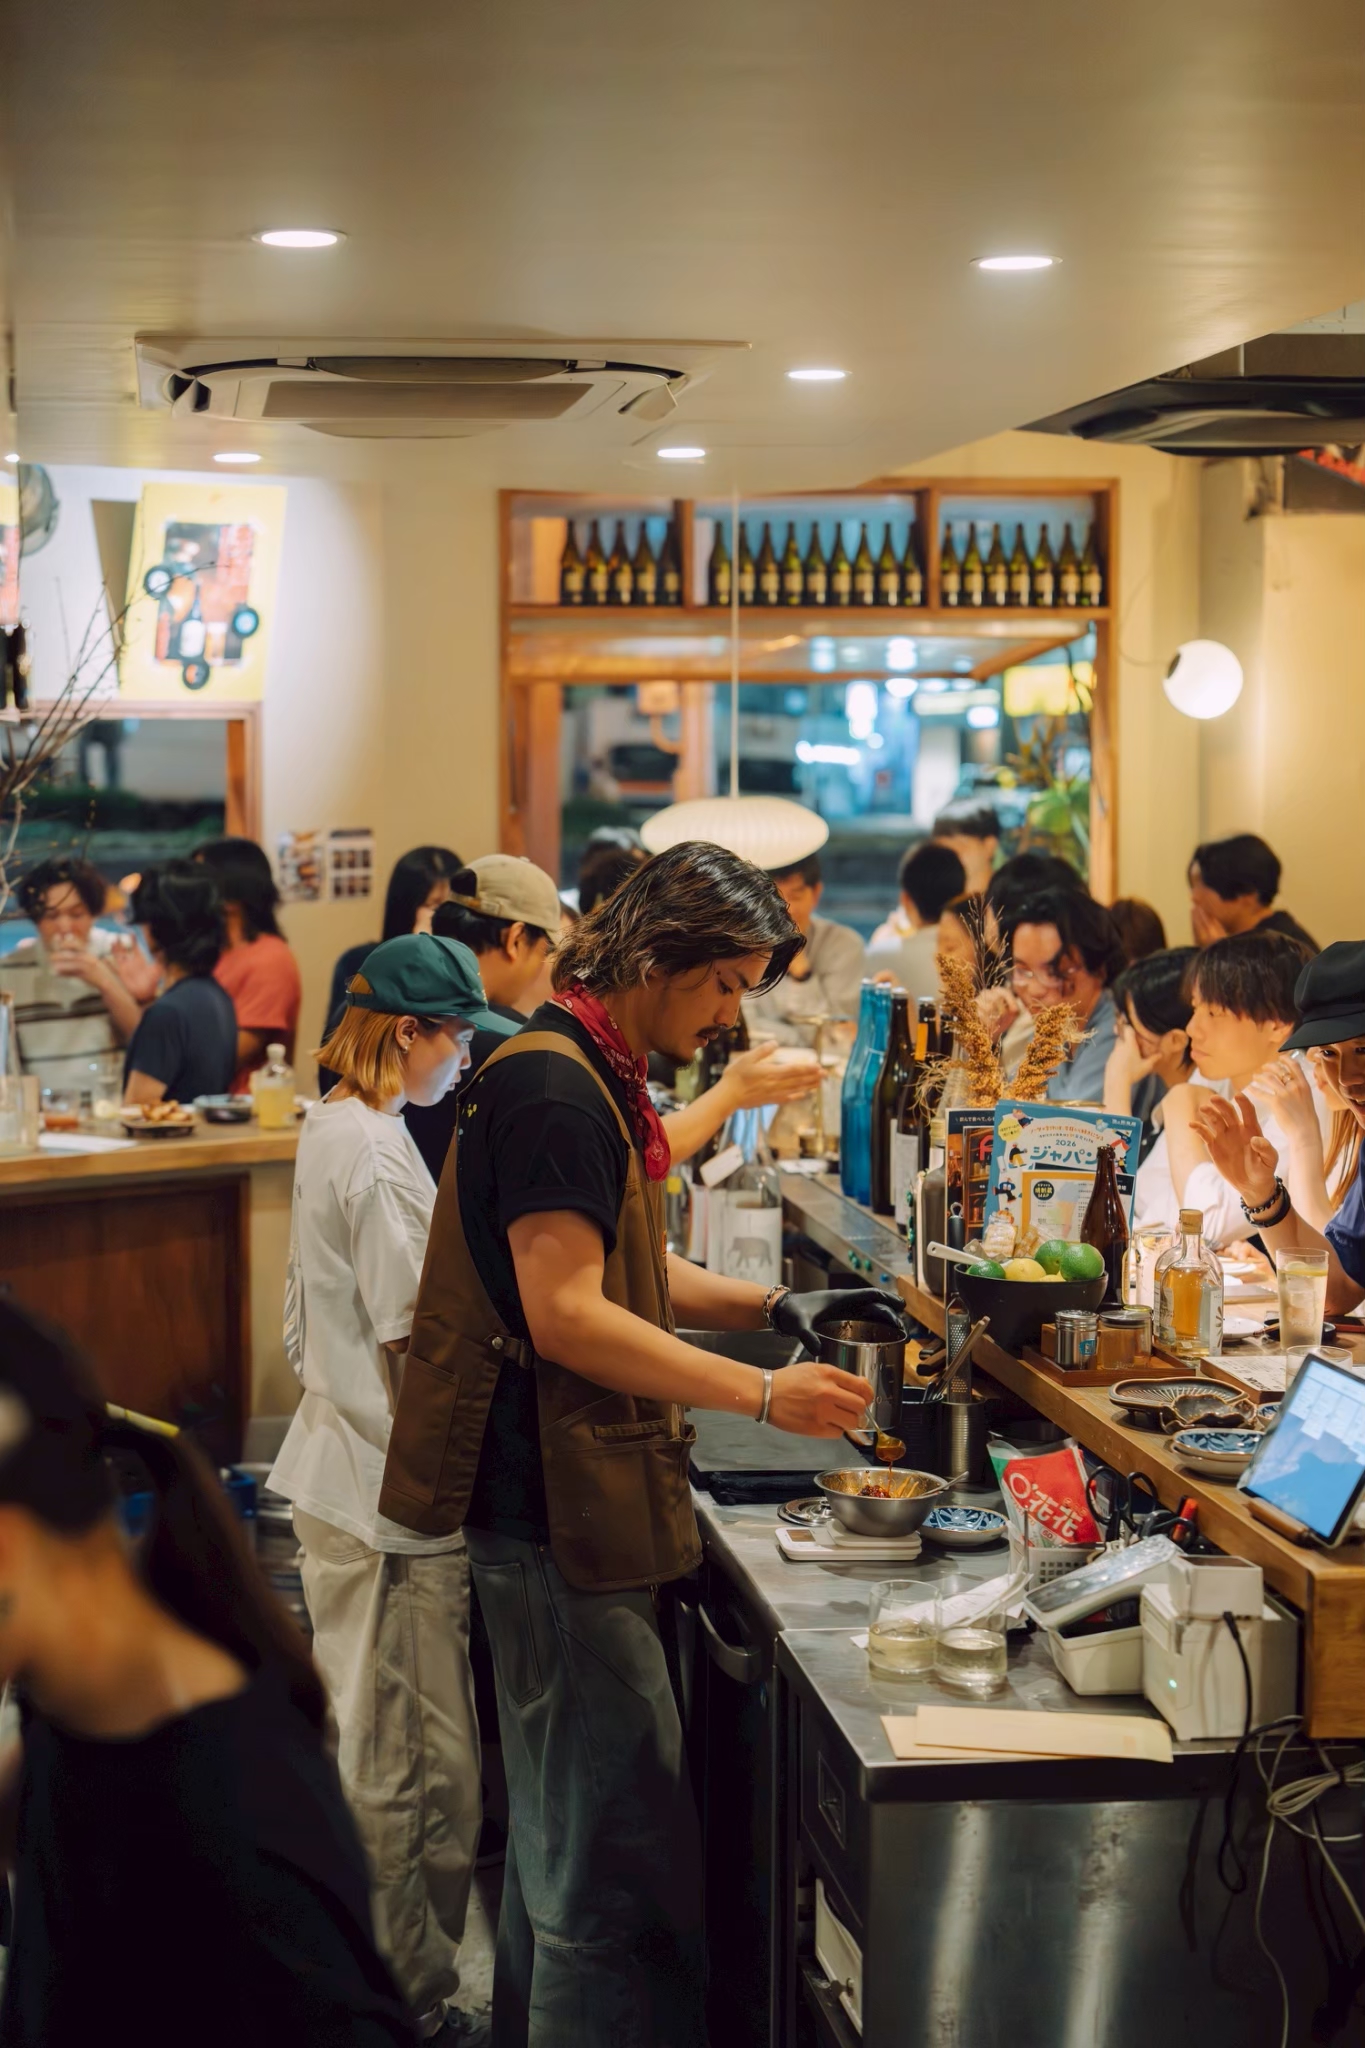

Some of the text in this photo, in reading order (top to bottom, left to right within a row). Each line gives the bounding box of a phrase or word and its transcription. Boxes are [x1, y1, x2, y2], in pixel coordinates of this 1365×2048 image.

[1055, 1138, 1077, 1148] 2026
[1030, 1145, 1098, 1165] ジャパン
